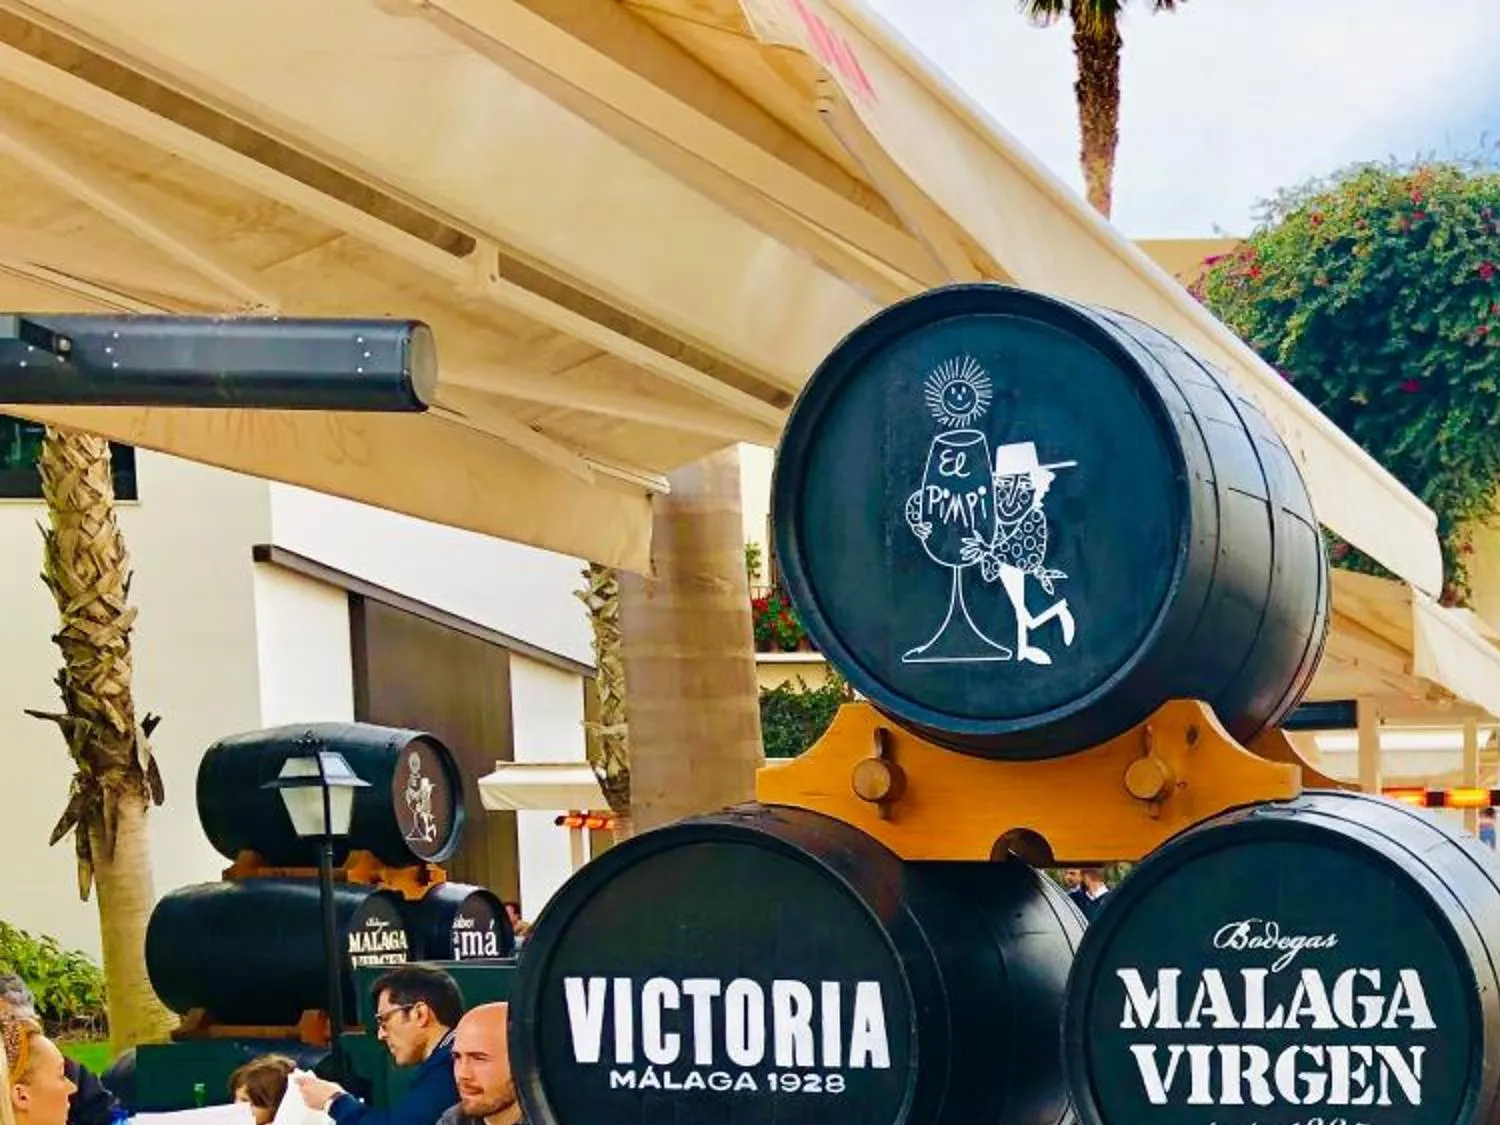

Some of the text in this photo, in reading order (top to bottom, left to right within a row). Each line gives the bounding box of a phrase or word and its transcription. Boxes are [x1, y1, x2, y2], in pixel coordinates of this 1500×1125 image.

[939, 449, 971, 477] El
[348, 929, 408, 953] MALAGA
[1213, 918, 1338, 973] Bodegas
[564, 976, 892, 1069] VICTORIA
[1116, 968, 1437, 1029] MALAGA
[609, 1065, 847, 1093] MÁLAGA 1928
[1130, 1044, 1426, 1105] VIRGEN
